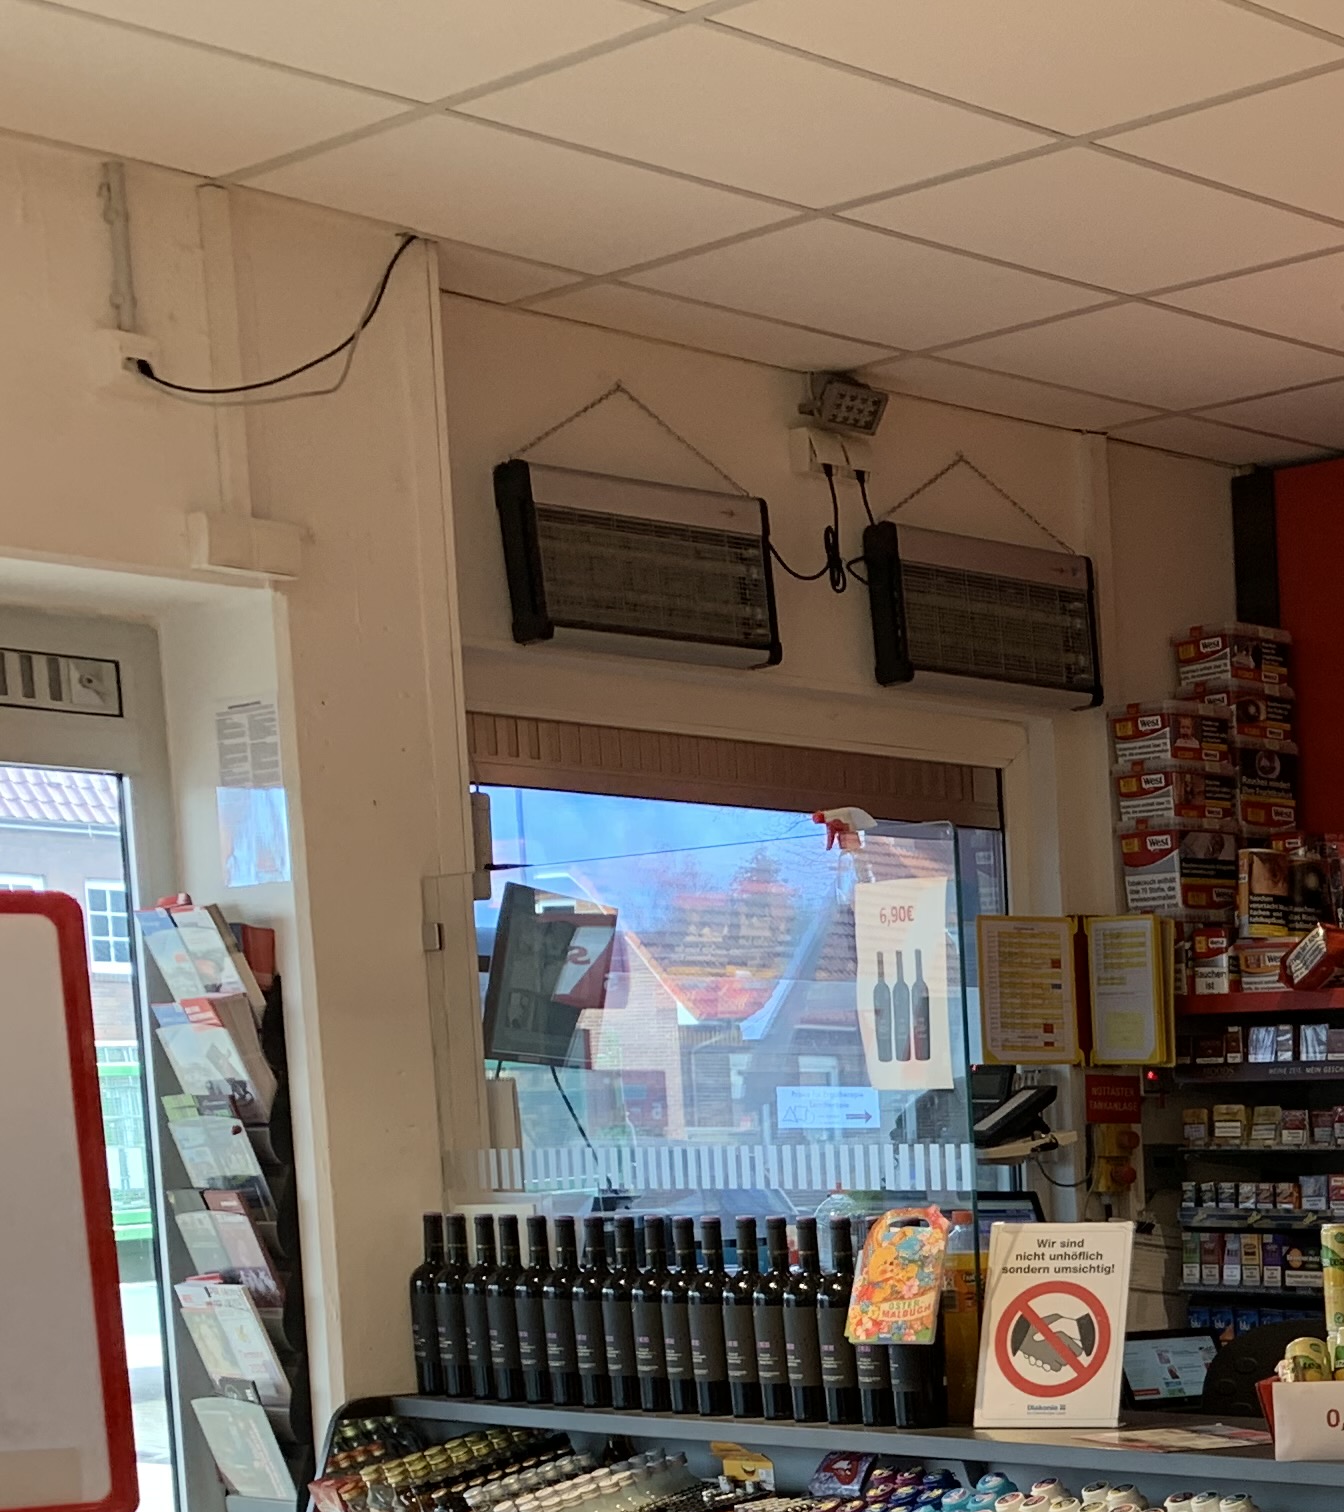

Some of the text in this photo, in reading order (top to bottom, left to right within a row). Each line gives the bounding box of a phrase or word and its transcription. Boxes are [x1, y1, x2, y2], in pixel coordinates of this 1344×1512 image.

[879, 905, 915, 926] 6,90€
[1036, 1238, 1084, 1250] Wir sind
[1015, 1249, 1103, 1262] nicht unhöflich
[1001, 1263, 1116, 1276] sondern umsichtig!
